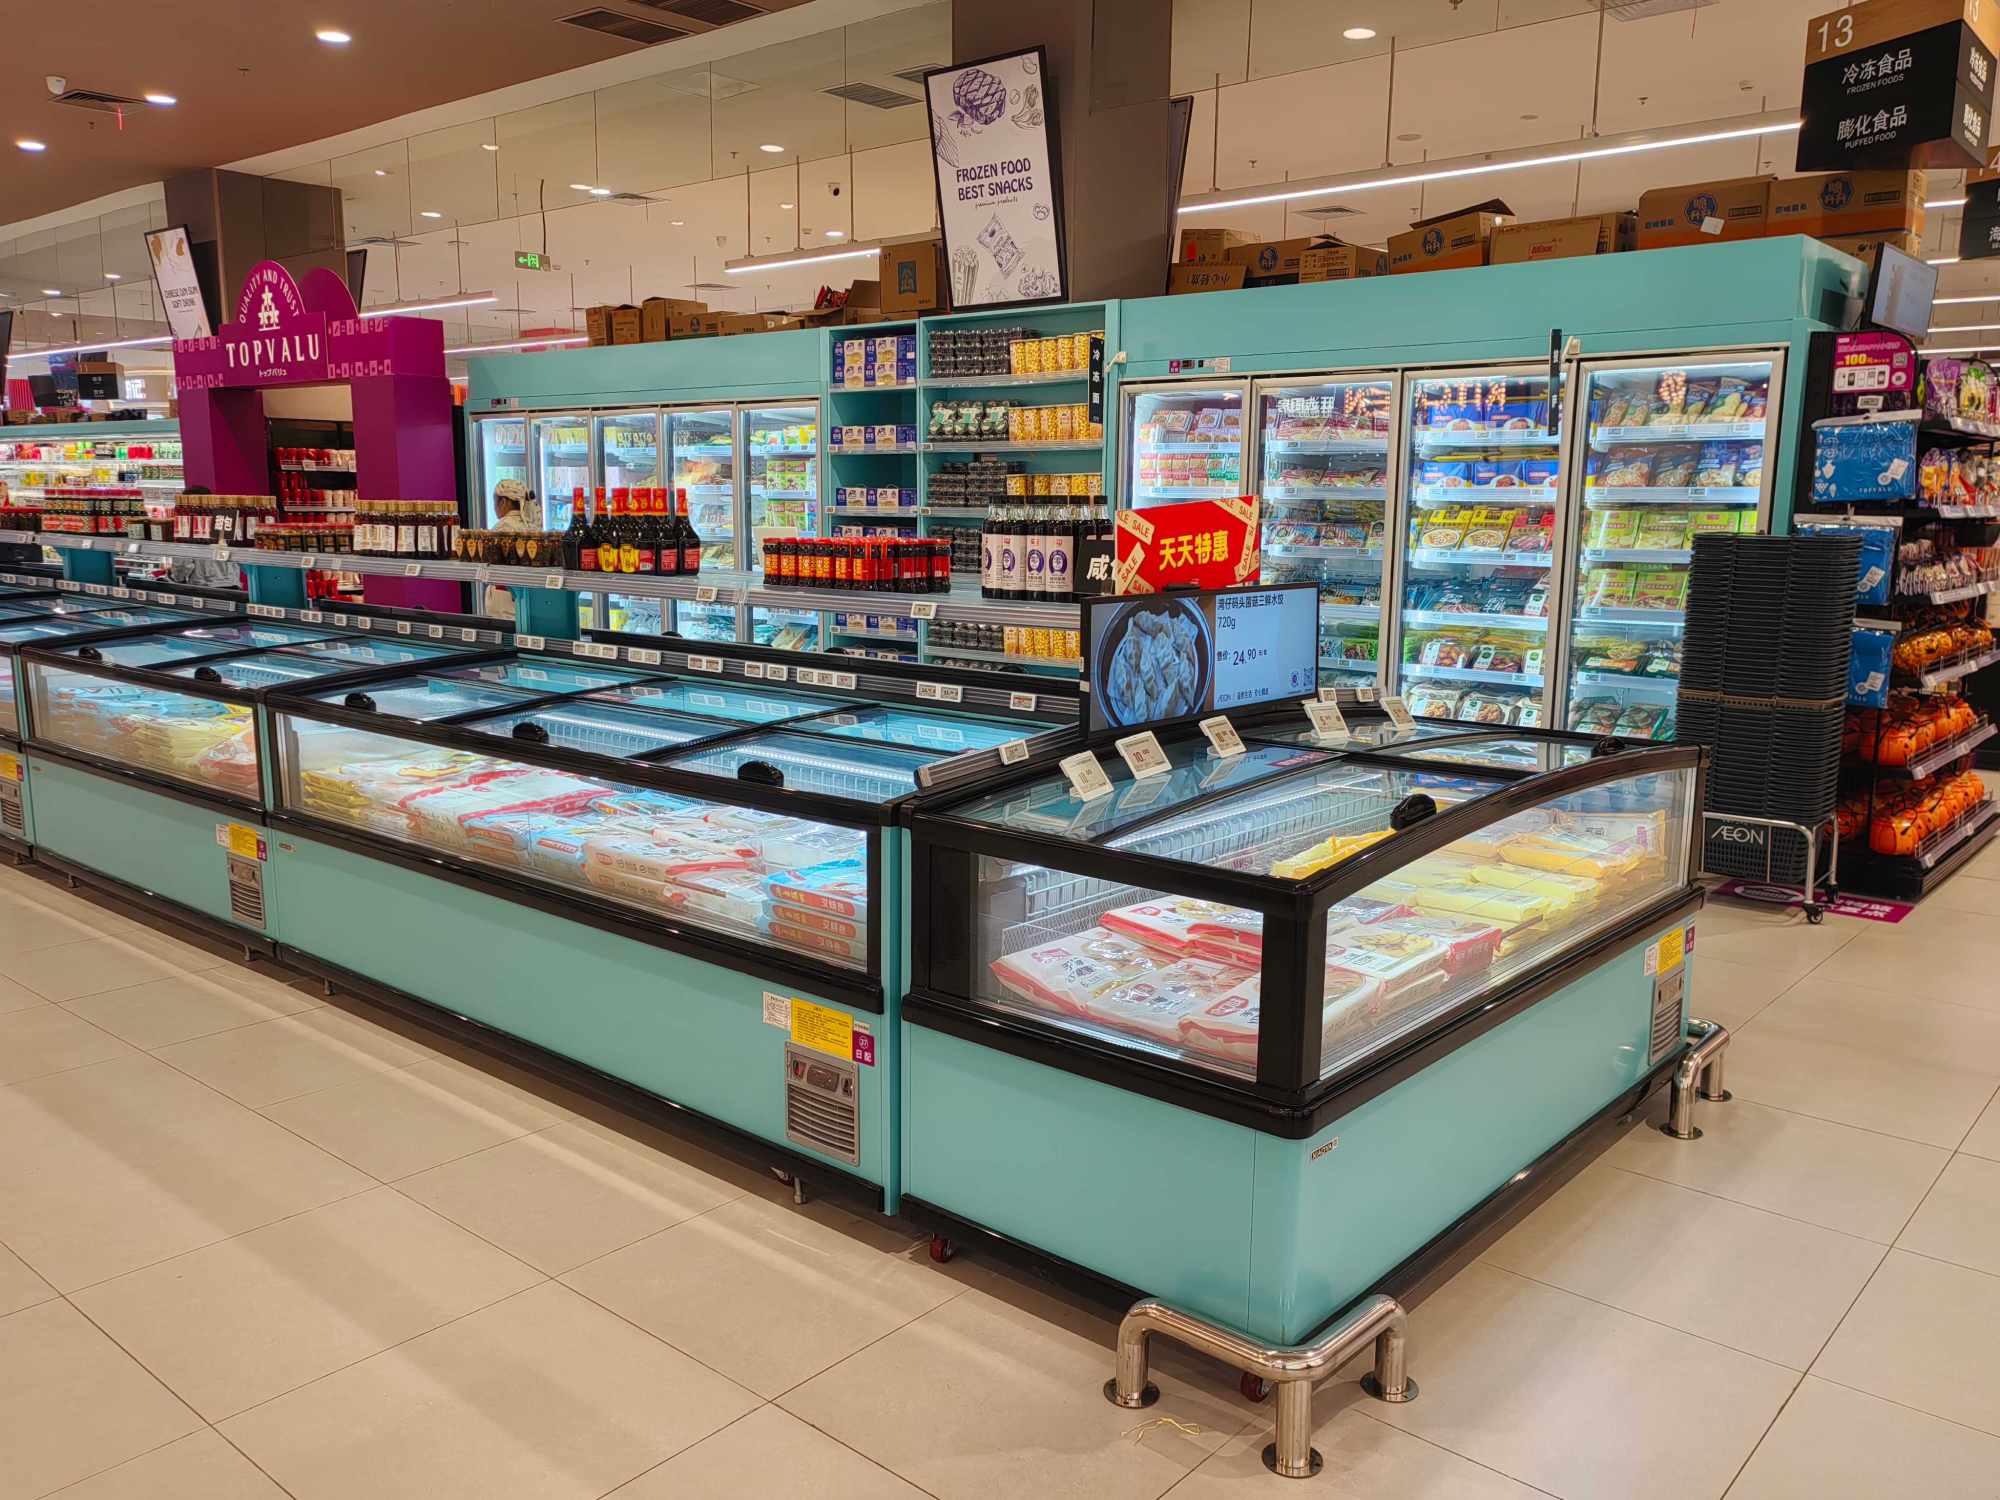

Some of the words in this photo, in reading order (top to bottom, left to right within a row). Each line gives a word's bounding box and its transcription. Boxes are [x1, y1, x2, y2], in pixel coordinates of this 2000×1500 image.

[1818, 15, 1853, 52] 13
[1842, 49, 1913, 85] 冷冻食品
[1847, 82, 1876, 95] FROZEN
[1878, 73, 1904, 87] FOODS
[1837, 105, 1908, 141] 膨化食品
[1845, 137, 1874, 149] PUFFED
[1876, 130, 1896, 143] FOOD
[956, 162, 998, 183] FROZEN
[1001, 157, 1032, 176] FOOD
[958, 183, 985, 201] BEST
[988, 176, 1034, 197] SNACKS
[240, 272, 261, 324] QUALITY
[263, 269, 278, 284] AND
[280, 277, 299, 317] TRUST
[226, 333, 320, 368] TOPVALU
[1844, 354, 1867, 366] 100
[1240, 505, 1254, 521] SALE
[1132, 519, 1151, 538] SALE
[1159, 530, 1228, 571] 天天特惠
[1121, 556, 1138, 582] SALE
[1217, 616, 1236, 630] 720g
[1233, 649, 1257, 665] 24.90
[1712, 825, 1764, 845] ÆON
